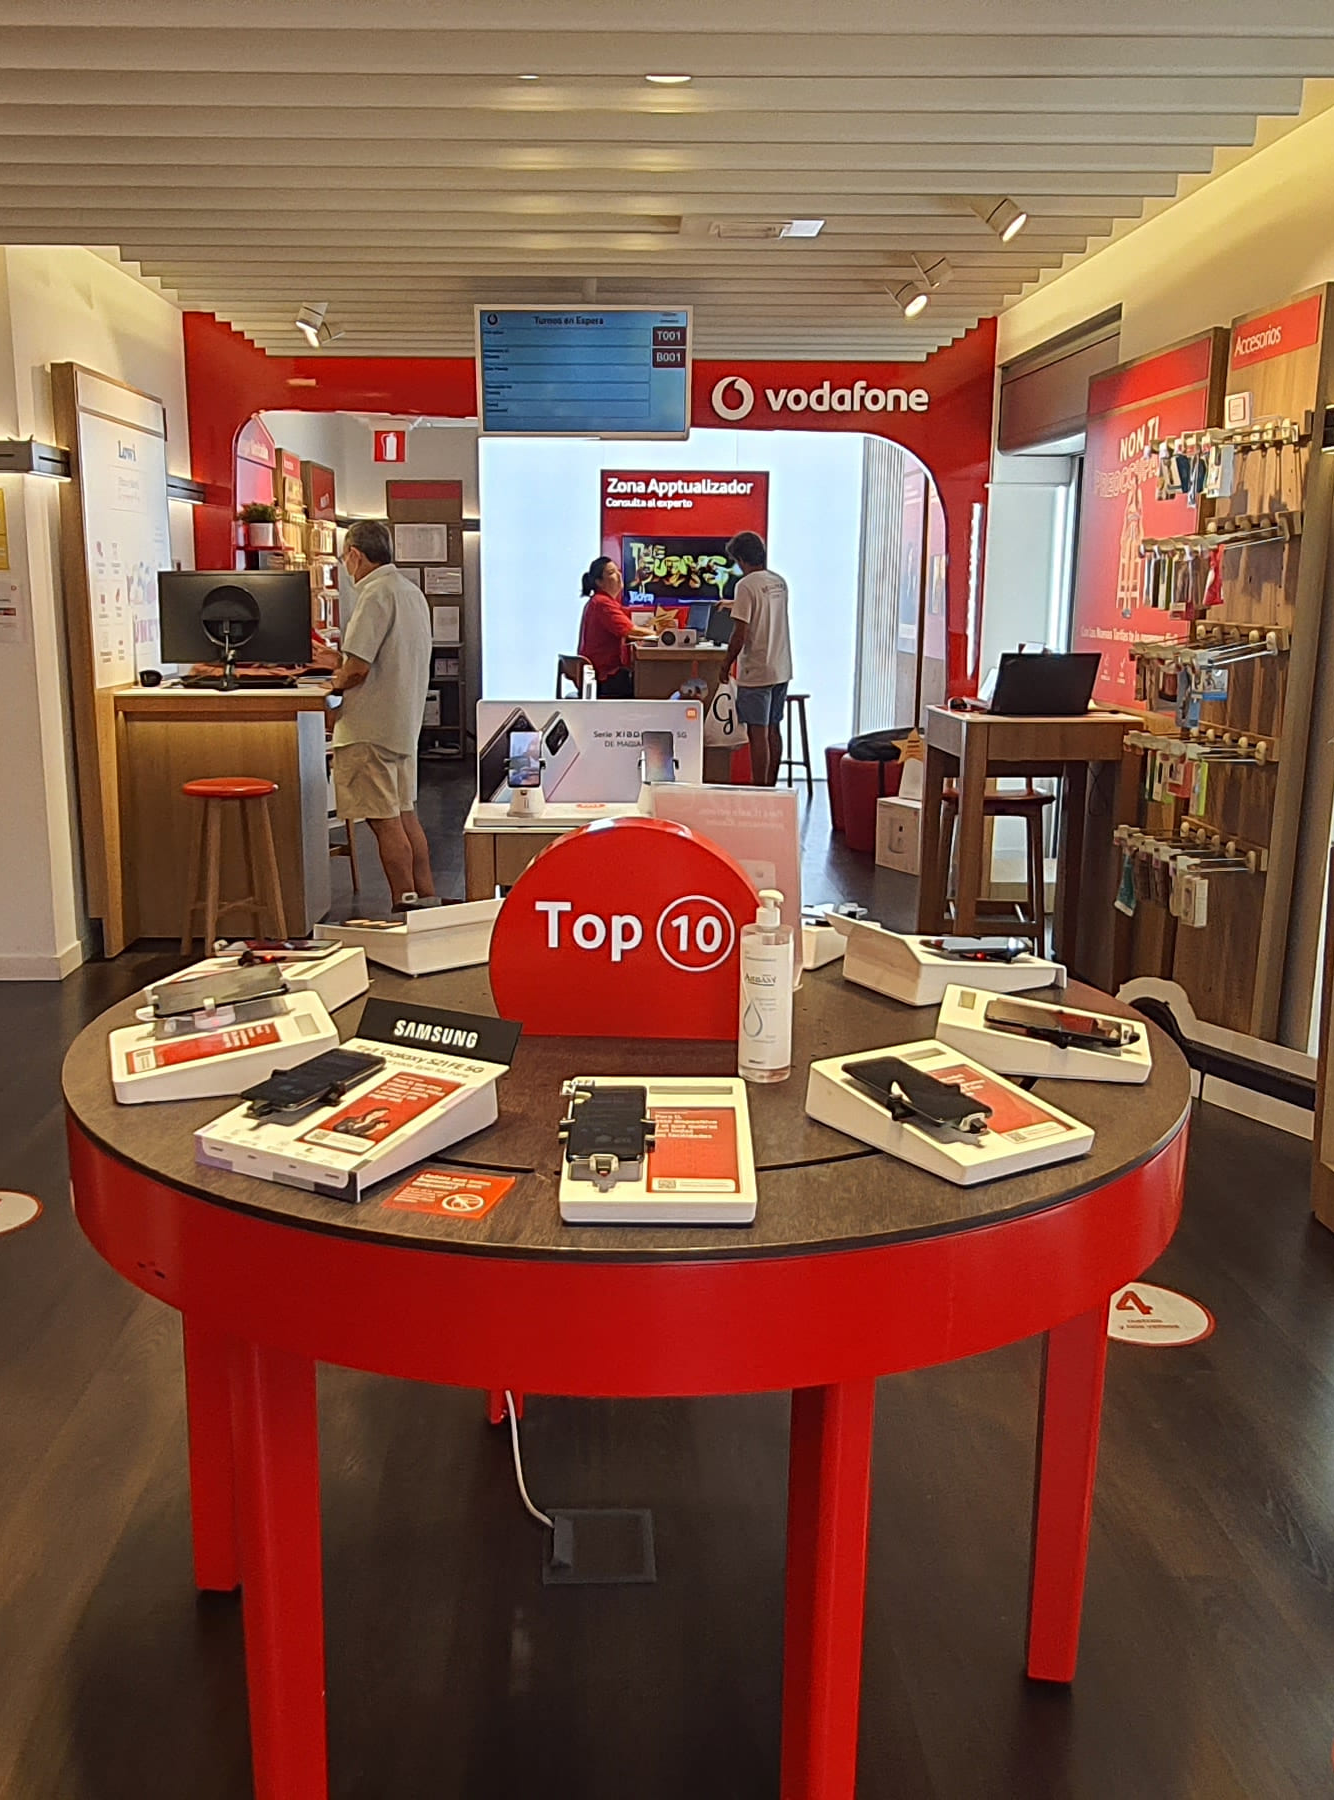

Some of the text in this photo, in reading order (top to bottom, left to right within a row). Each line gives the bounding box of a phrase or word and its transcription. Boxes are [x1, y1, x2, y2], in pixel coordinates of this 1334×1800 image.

[535, 316, 604, 325] Turnos en Espera
[657, 331, 681, 341] T001
[1234, 324, 1282, 357] Accesorios
[657, 352, 681, 362] B001
[765, 380, 929, 412] vodafone
[1120, 423, 1145, 462] NON
[607, 478, 754, 497] Zona Apptualizador
[606, 498, 646, 508] Consulta
[657, 499, 693, 509] experto
[535, 901, 722, 962] Top 10
[394, 1020, 478, 1048] SAMSUNG
[381, 1050, 424, 1063] Galaxy
[1116, 1291, 1154, 1315] 4
